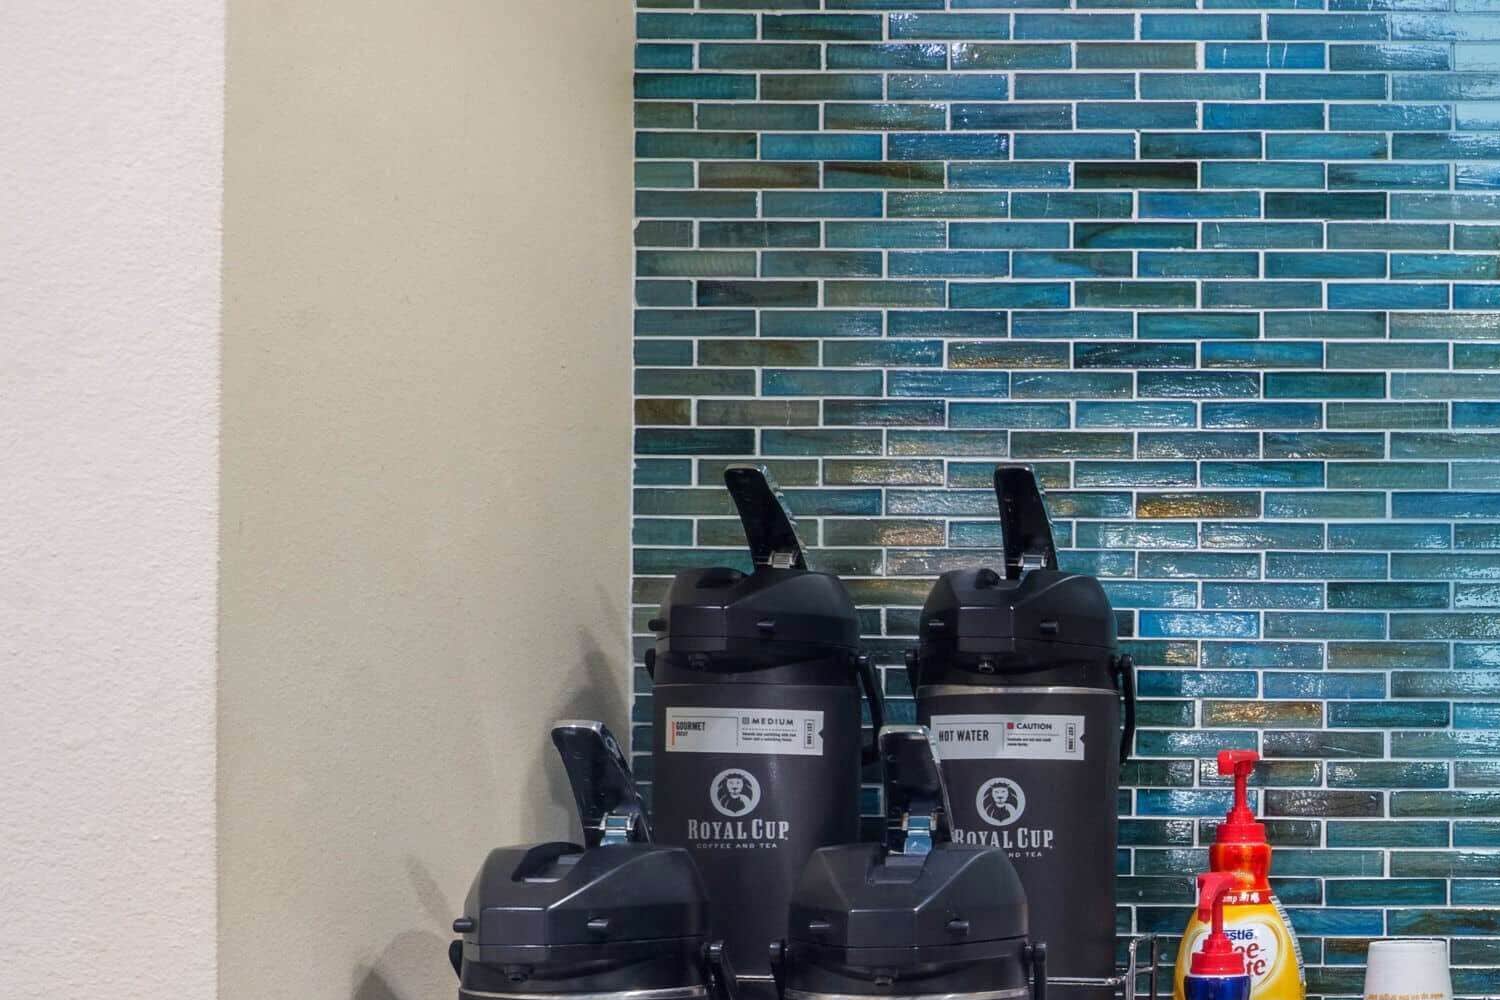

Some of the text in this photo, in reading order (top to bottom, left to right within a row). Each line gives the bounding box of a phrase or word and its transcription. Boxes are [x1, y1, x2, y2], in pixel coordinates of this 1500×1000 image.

[752, 718, 793, 726] MEDIUM
[1016, 722, 1053, 730] CAUTION
[938, 729, 989, 742] HOT WATER
[688, 818, 789, 840] ROYAL CUP
[954, 827, 1053, 849] ROYAL CUP
